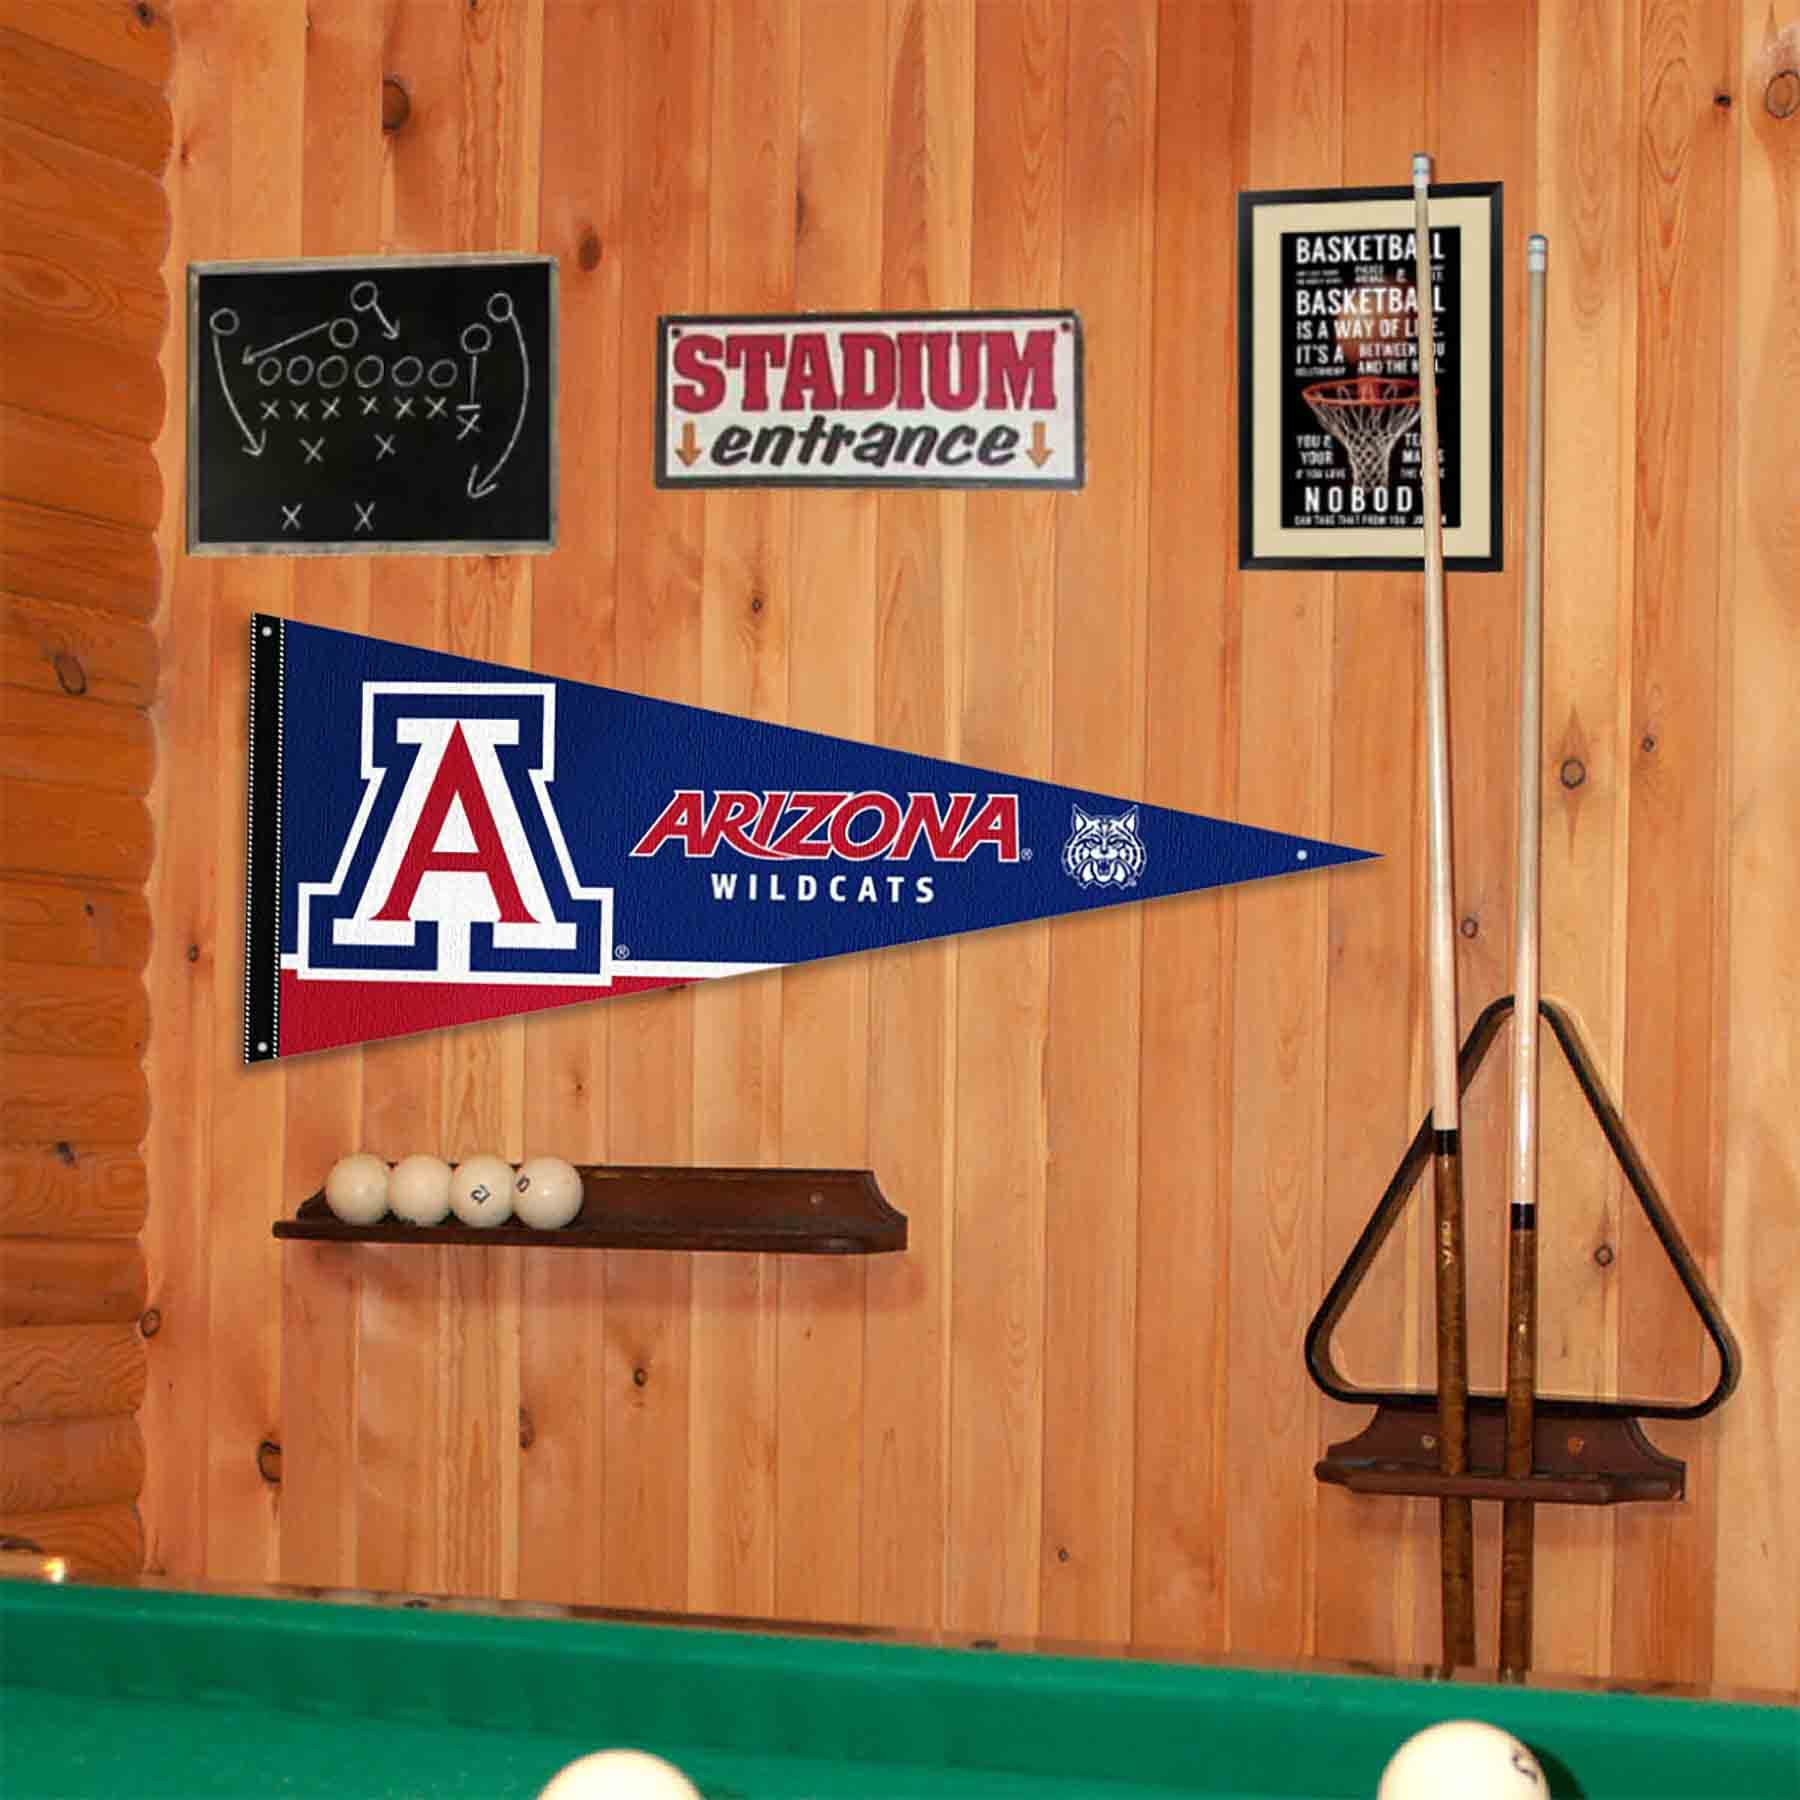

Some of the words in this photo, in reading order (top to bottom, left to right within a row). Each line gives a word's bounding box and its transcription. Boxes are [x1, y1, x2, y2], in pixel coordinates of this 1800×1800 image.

[1296, 232, 1445, 264] BASKETBAL
[1296, 285, 1446, 316] BASKETBAL
[1296, 320, 1312, 340] IS
[1317, 320, 1329, 339] A
[1333, 318, 1375, 338] WAY
[1379, 318, 1400, 337] OF
[1296, 344, 1329, 364] IT'S
[1334, 344, 1345, 364] A
[672, 330, 1058, 414] STADIUM
[711, 415, 1020, 468] entrance
[629, 790, 1020, 863] ARIZONA
[711, 873, 935, 903] WILDCATS
